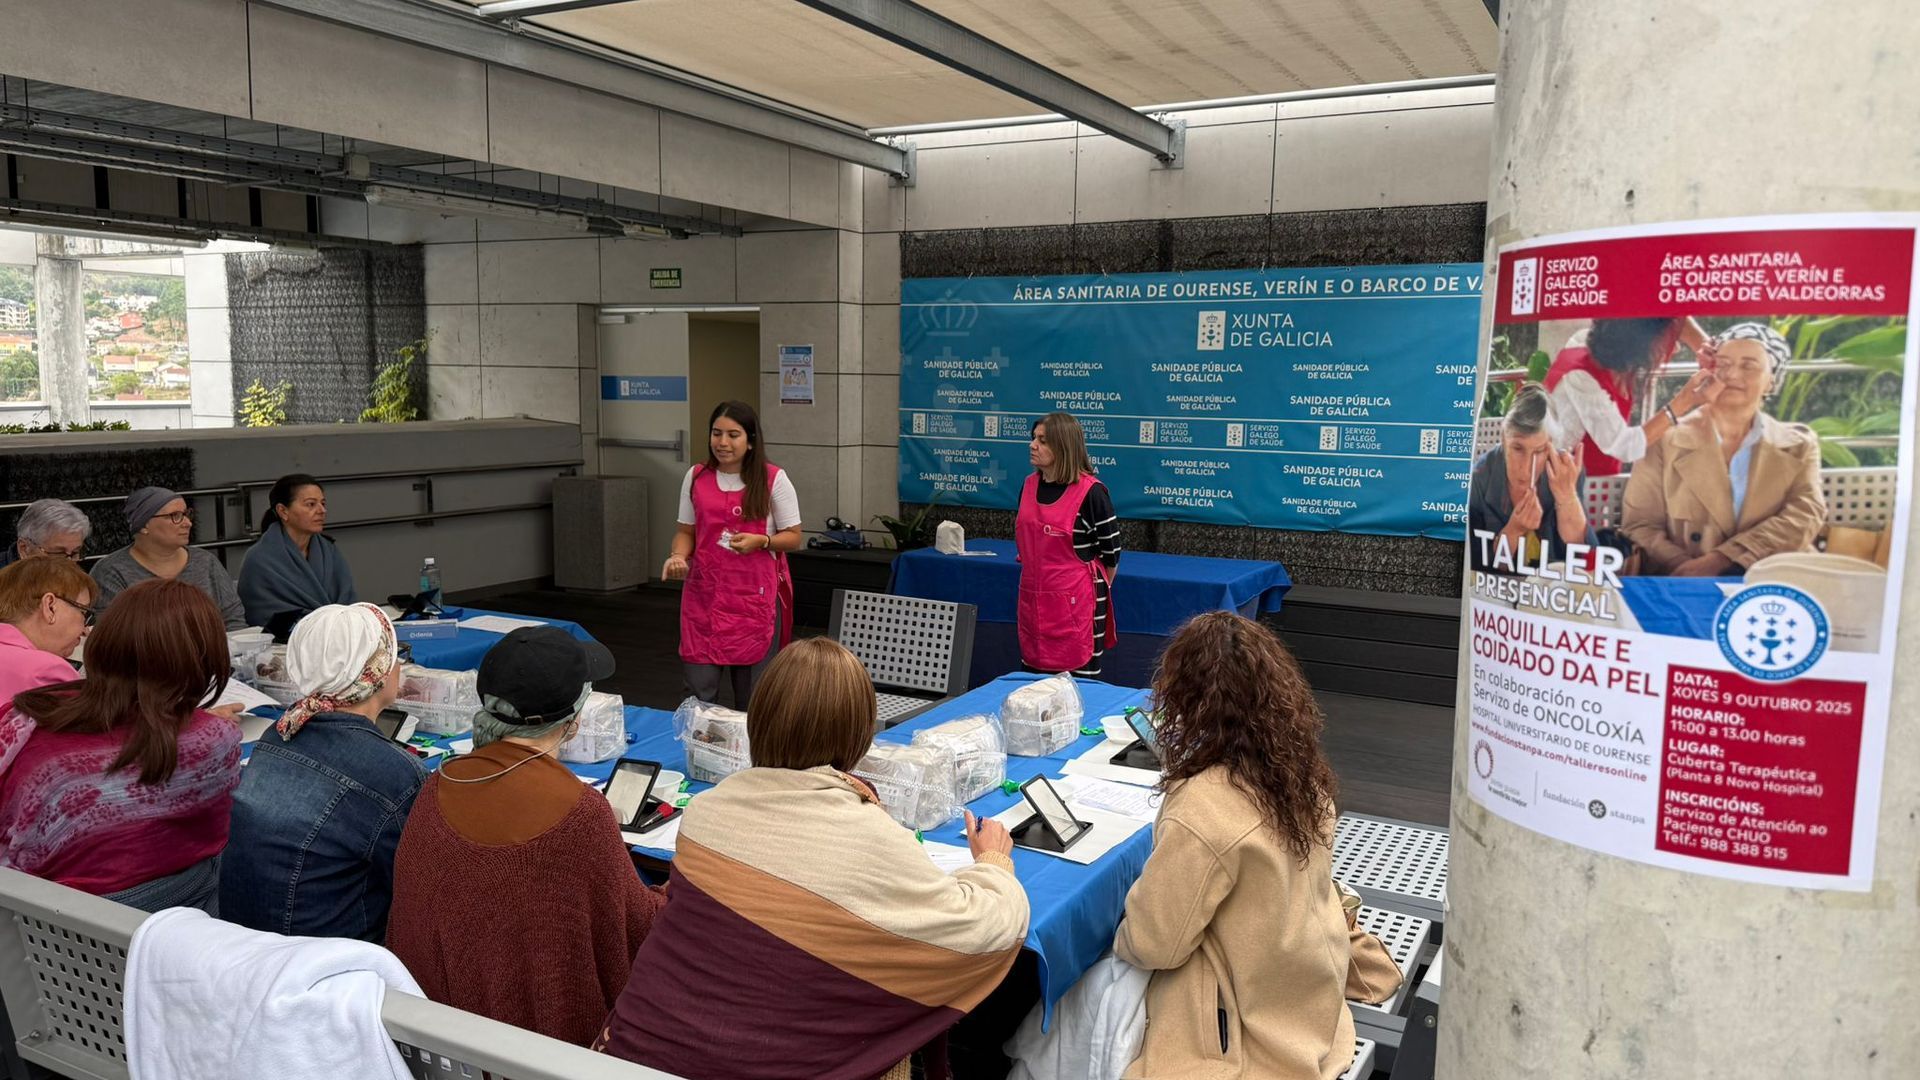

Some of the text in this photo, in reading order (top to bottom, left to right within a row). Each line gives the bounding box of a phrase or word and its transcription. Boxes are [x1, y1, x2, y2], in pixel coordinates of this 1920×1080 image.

[1546, 256, 1598, 273] SERVIZO
[1661, 252, 1803, 270] ÁREA SANITARIA
[1545, 273, 1598, 290] GALEGO
[1660, 265, 1844, 286] DE OURENSE, VERÍN E
[1014, 284, 1052, 300] ÁREA
[1057, 285, 1141, 299] SANITARIA
[1147, 284, 1167, 297] DE
[1173, 281, 1258, 298] OURENSE,
[1264, 276, 1317, 295] VERÍN
[1325, 280, 1334, 293] E
[1341, 279, 1353, 293] O
[1361, 277, 1426, 293] BARCO
[1434, 276, 1459, 291] DE
[1659, 285, 1885, 302] O BARCO DE VALDEORRAS
[1544, 288, 1608, 307] DE SAÚDE
[1232, 313, 1294, 328] XUNTA
[1231, 331, 1333, 347] DE GALICIA
[924, 359, 998, 370] SANIDADE PÚBLICA
[1074, 362, 1103, 370] PÚBLICA
[1152, 362, 1243, 372] SANIDADE PÚBLICA
[1335, 363, 1369, 371] PÚBLICA
[939, 370, 983, 379] DE GALICIA
[1170, 373, 1223, 382] DE GALICIA
[1457, 377, 1472, 385] DE
[937, 389, 994, 398] SANIDADE PÚBLICA
[1040, 390, 1121, 401] SANIDADE PÚBLICA
[1205, 394, 1236, 403] PÚBLICA
[1056, 401, 1104, 410] DE GALICIA
[1290, 394, 1391, 406] SANIDADE PÚBLICA
[1310, 407, 1369, 416] DE GALICIA
[1172, 434, 1192, 443] SAÚDE
[1250, 431, 1279, 439] GALEGO
[1345, 434, 1376, 442] GALEGO
[1261, 437, 1284, 446] SAÚDE
[1356, 440, 1382, 449] SAÚDE
[1161, 460, 1230, 469] SANIDADE PÚBLICA
[1186, 468, 1215, 476] GALICIA
[1283, 465, 1383, 478] SANIDADE PÚBLICA
[920, 472, 993, 484] SANIDADE PÚBLICA
[1303, 477, 1361, 487] DE GALICIA
[934, 482, 978, 492] DE GALICIA
[1144, 486, 1233, 498] SANIDADE PÚBLICA
[1161, 497, 1214, 508] DE GALICIA
[1282, 498, 1357, 508] SANIDADE PÚBLICA
[1309, 507, 1341, 515] GALICIA
[1444, 514, 1458, 522] DE
[1474, 529, 1624, 588] TALLER
[1475, 572, 1616, 620] PRESENCIAL
[1474, 608, 1631, 662] MAQUILLAXE E
[1473, 634, 1660, 697] COIDADO DA PEL
[1674, 672, 1719, 688] DATA:
[1474, 664, 1602, 714] En colaboración co
[1672, 685, 1852, 714] XOVES 9 OUTUBRO 2025
[1474, 683, 1645, 745] Servizo de ONCOLOXÍA
[1671, 705, 1745, 726] HORARIO:
[1473, 703, 1651, 765] HOSPITAL UNIVERSITARIO DE OURENSE
[1670, 720, 1806, 746] 11:00 a 13.00 horas
[1669, 739, 1725, 757] LUGAR:
[1668, 753, 1816, 782] Cuberta Terapéutica
[1667, 767, 1823, 797] (Planta 8 Novo Hospital)
[1665, 789, 1764, 815] INSCRICIÓNS:
[1664, 803, 1827, 835] Servizo de Atención ao
[1663, 816, 1771, 844] Paciente CHUO
[1663, 830, 1788, 860] Telf.: 988 388 515
